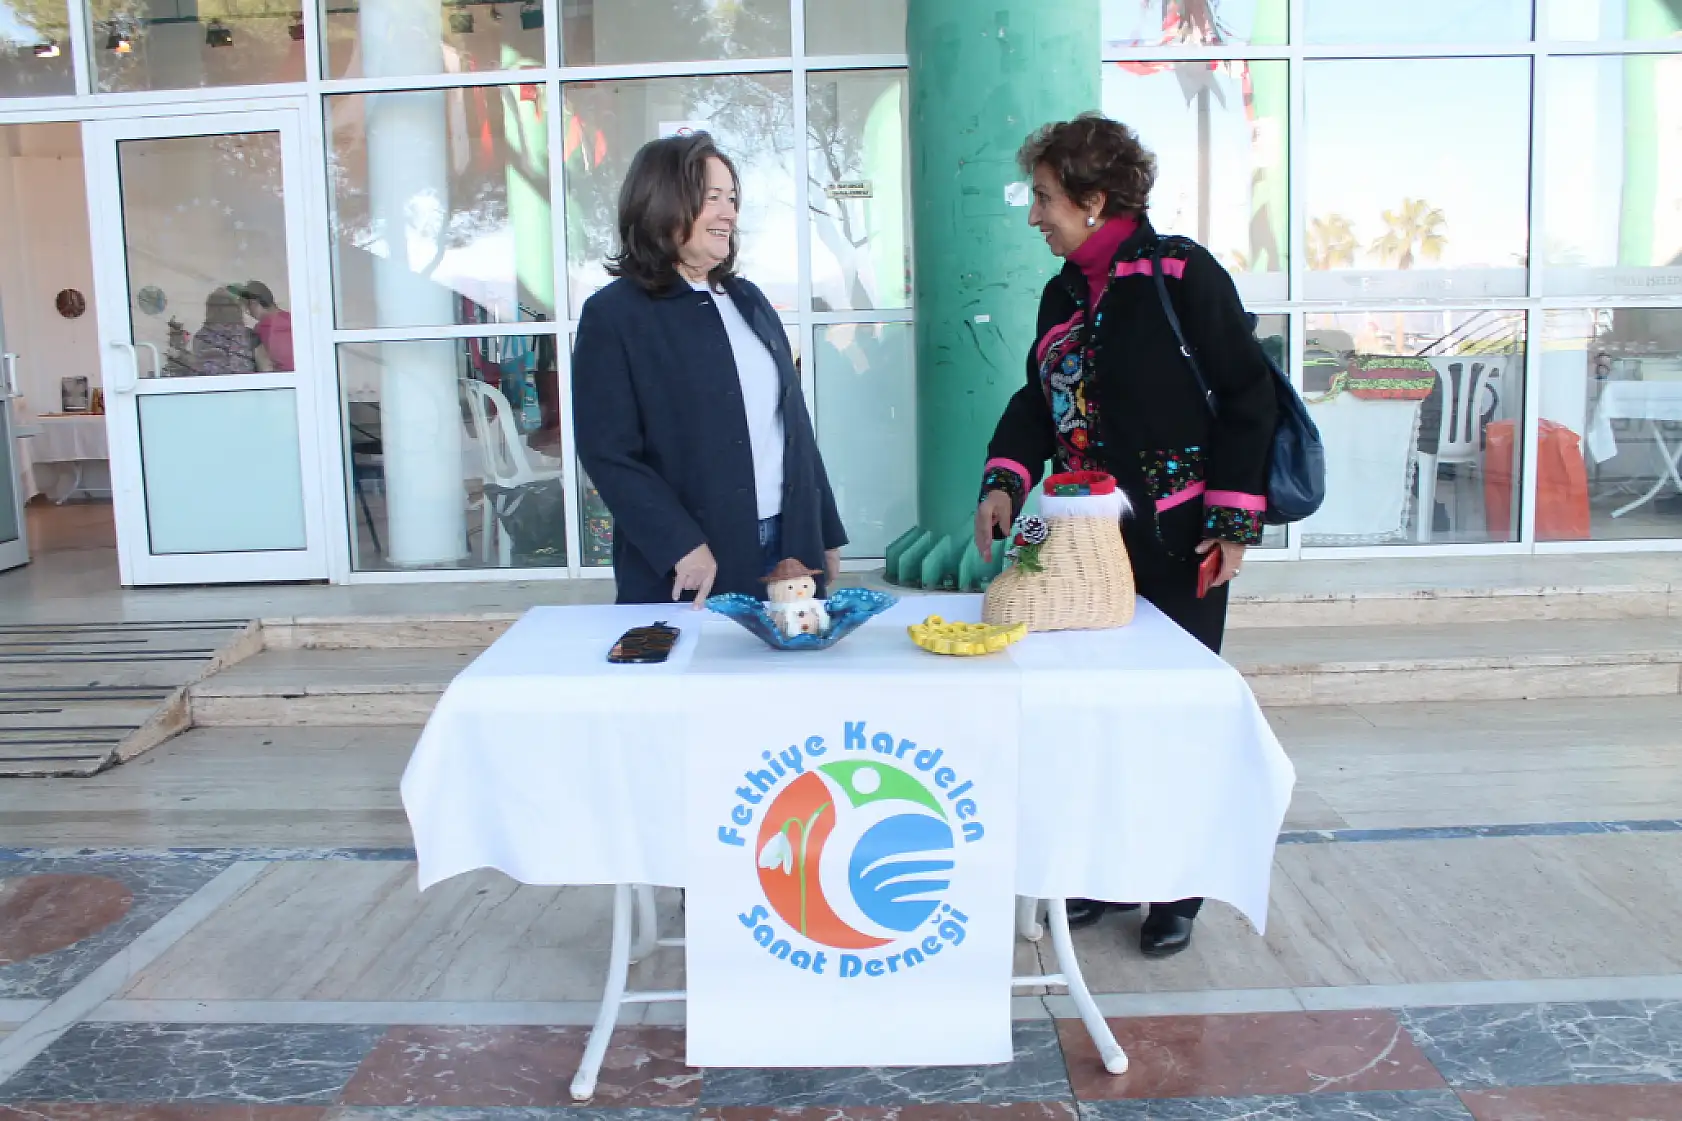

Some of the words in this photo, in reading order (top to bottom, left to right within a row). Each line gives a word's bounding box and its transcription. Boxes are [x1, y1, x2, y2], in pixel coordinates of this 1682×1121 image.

[718, 735, 827, 847] Fethiye
[843, 721, 985, 843] Kardelen
[738, 904, 827, 975] Sanat
[839, 904, 968, 978] Derneği
